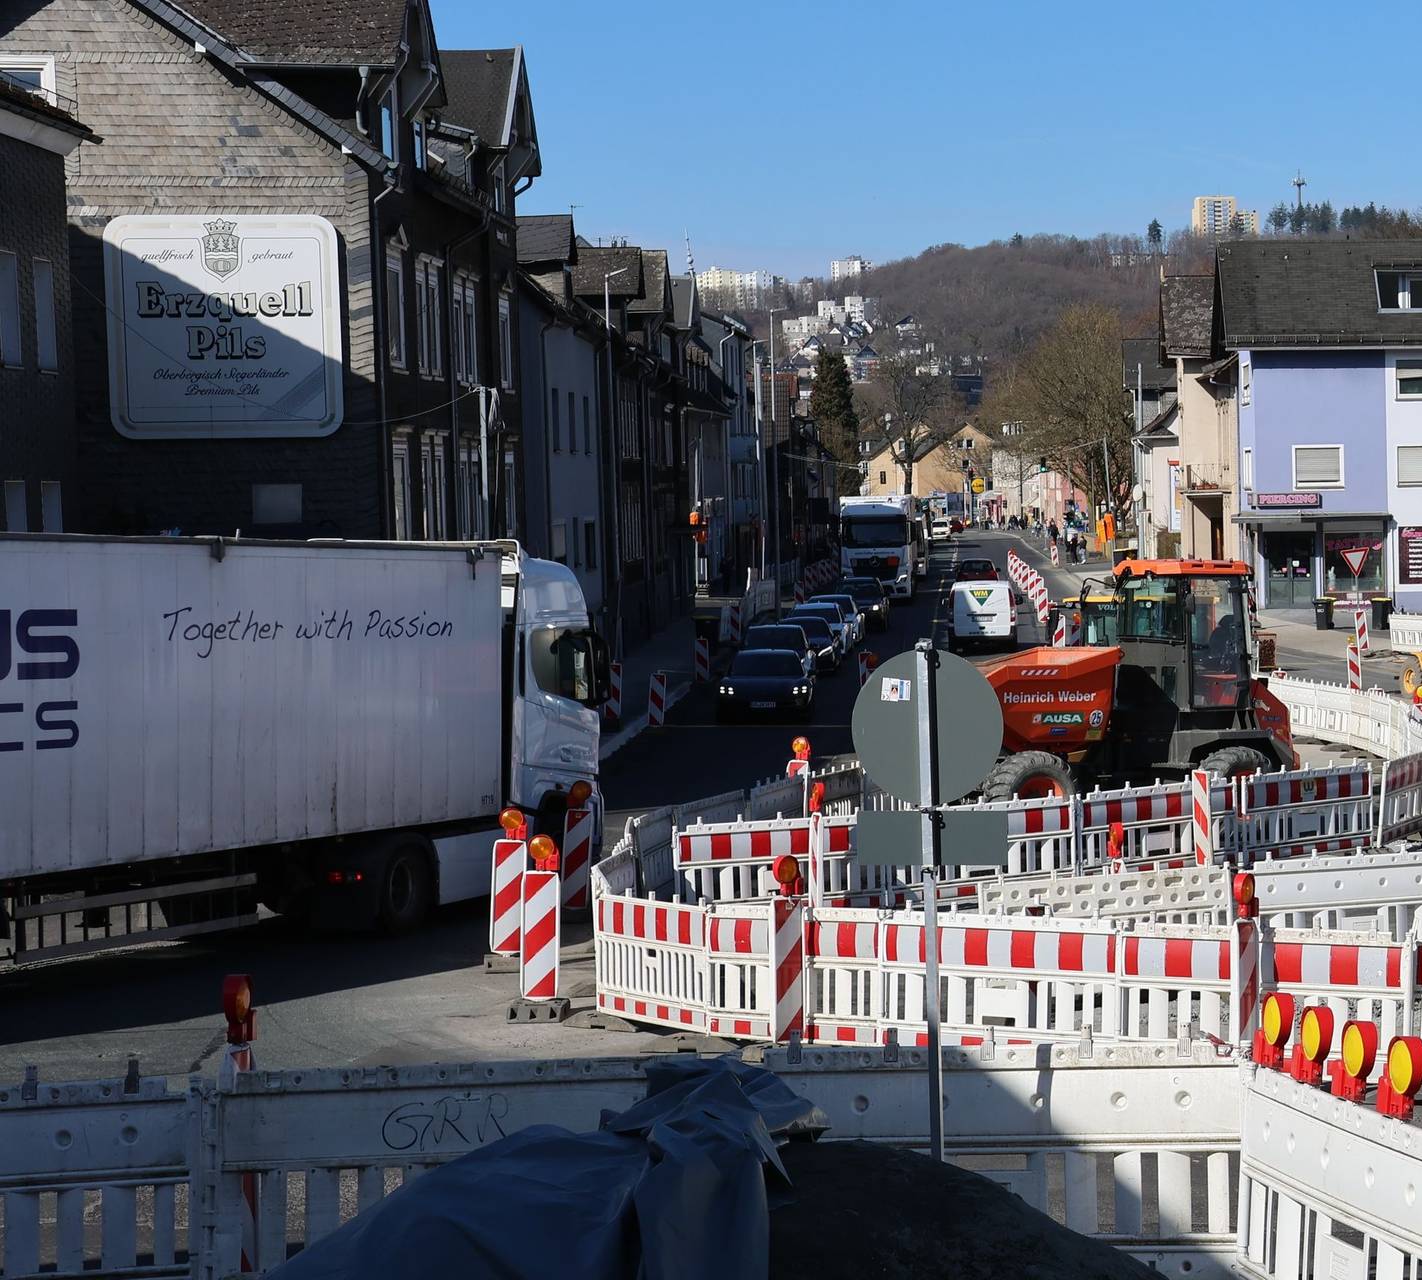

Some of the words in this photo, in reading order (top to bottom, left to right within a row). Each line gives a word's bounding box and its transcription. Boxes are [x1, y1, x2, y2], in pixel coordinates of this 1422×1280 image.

[141, 248, 194, 263] quellfrisch
[248, 249, 293, 263] gebraut
[136, 281, 313, 322] Erzquell
[185, 325, 266, 360] Pils
[153, 367, 222, 380] Oberbergisch
[224, 366, 289, 379] Siegerländer
[184, 386, 235, 396] Premium
[237, 385, 260, 396] Pils
[1259, 494, 1317, 504] PIERCING
[163, 607, 283, 658] Together
[295, 609, 352, 641] with
[364, 609, 453, 639] Passion
[1003, 691, 1054, 703] Heinrich
[1058, 691, 1096, 702] Weber
[1043, 714, 1082, 723] AUSA
[1092, 712, 1102, 725] 25
